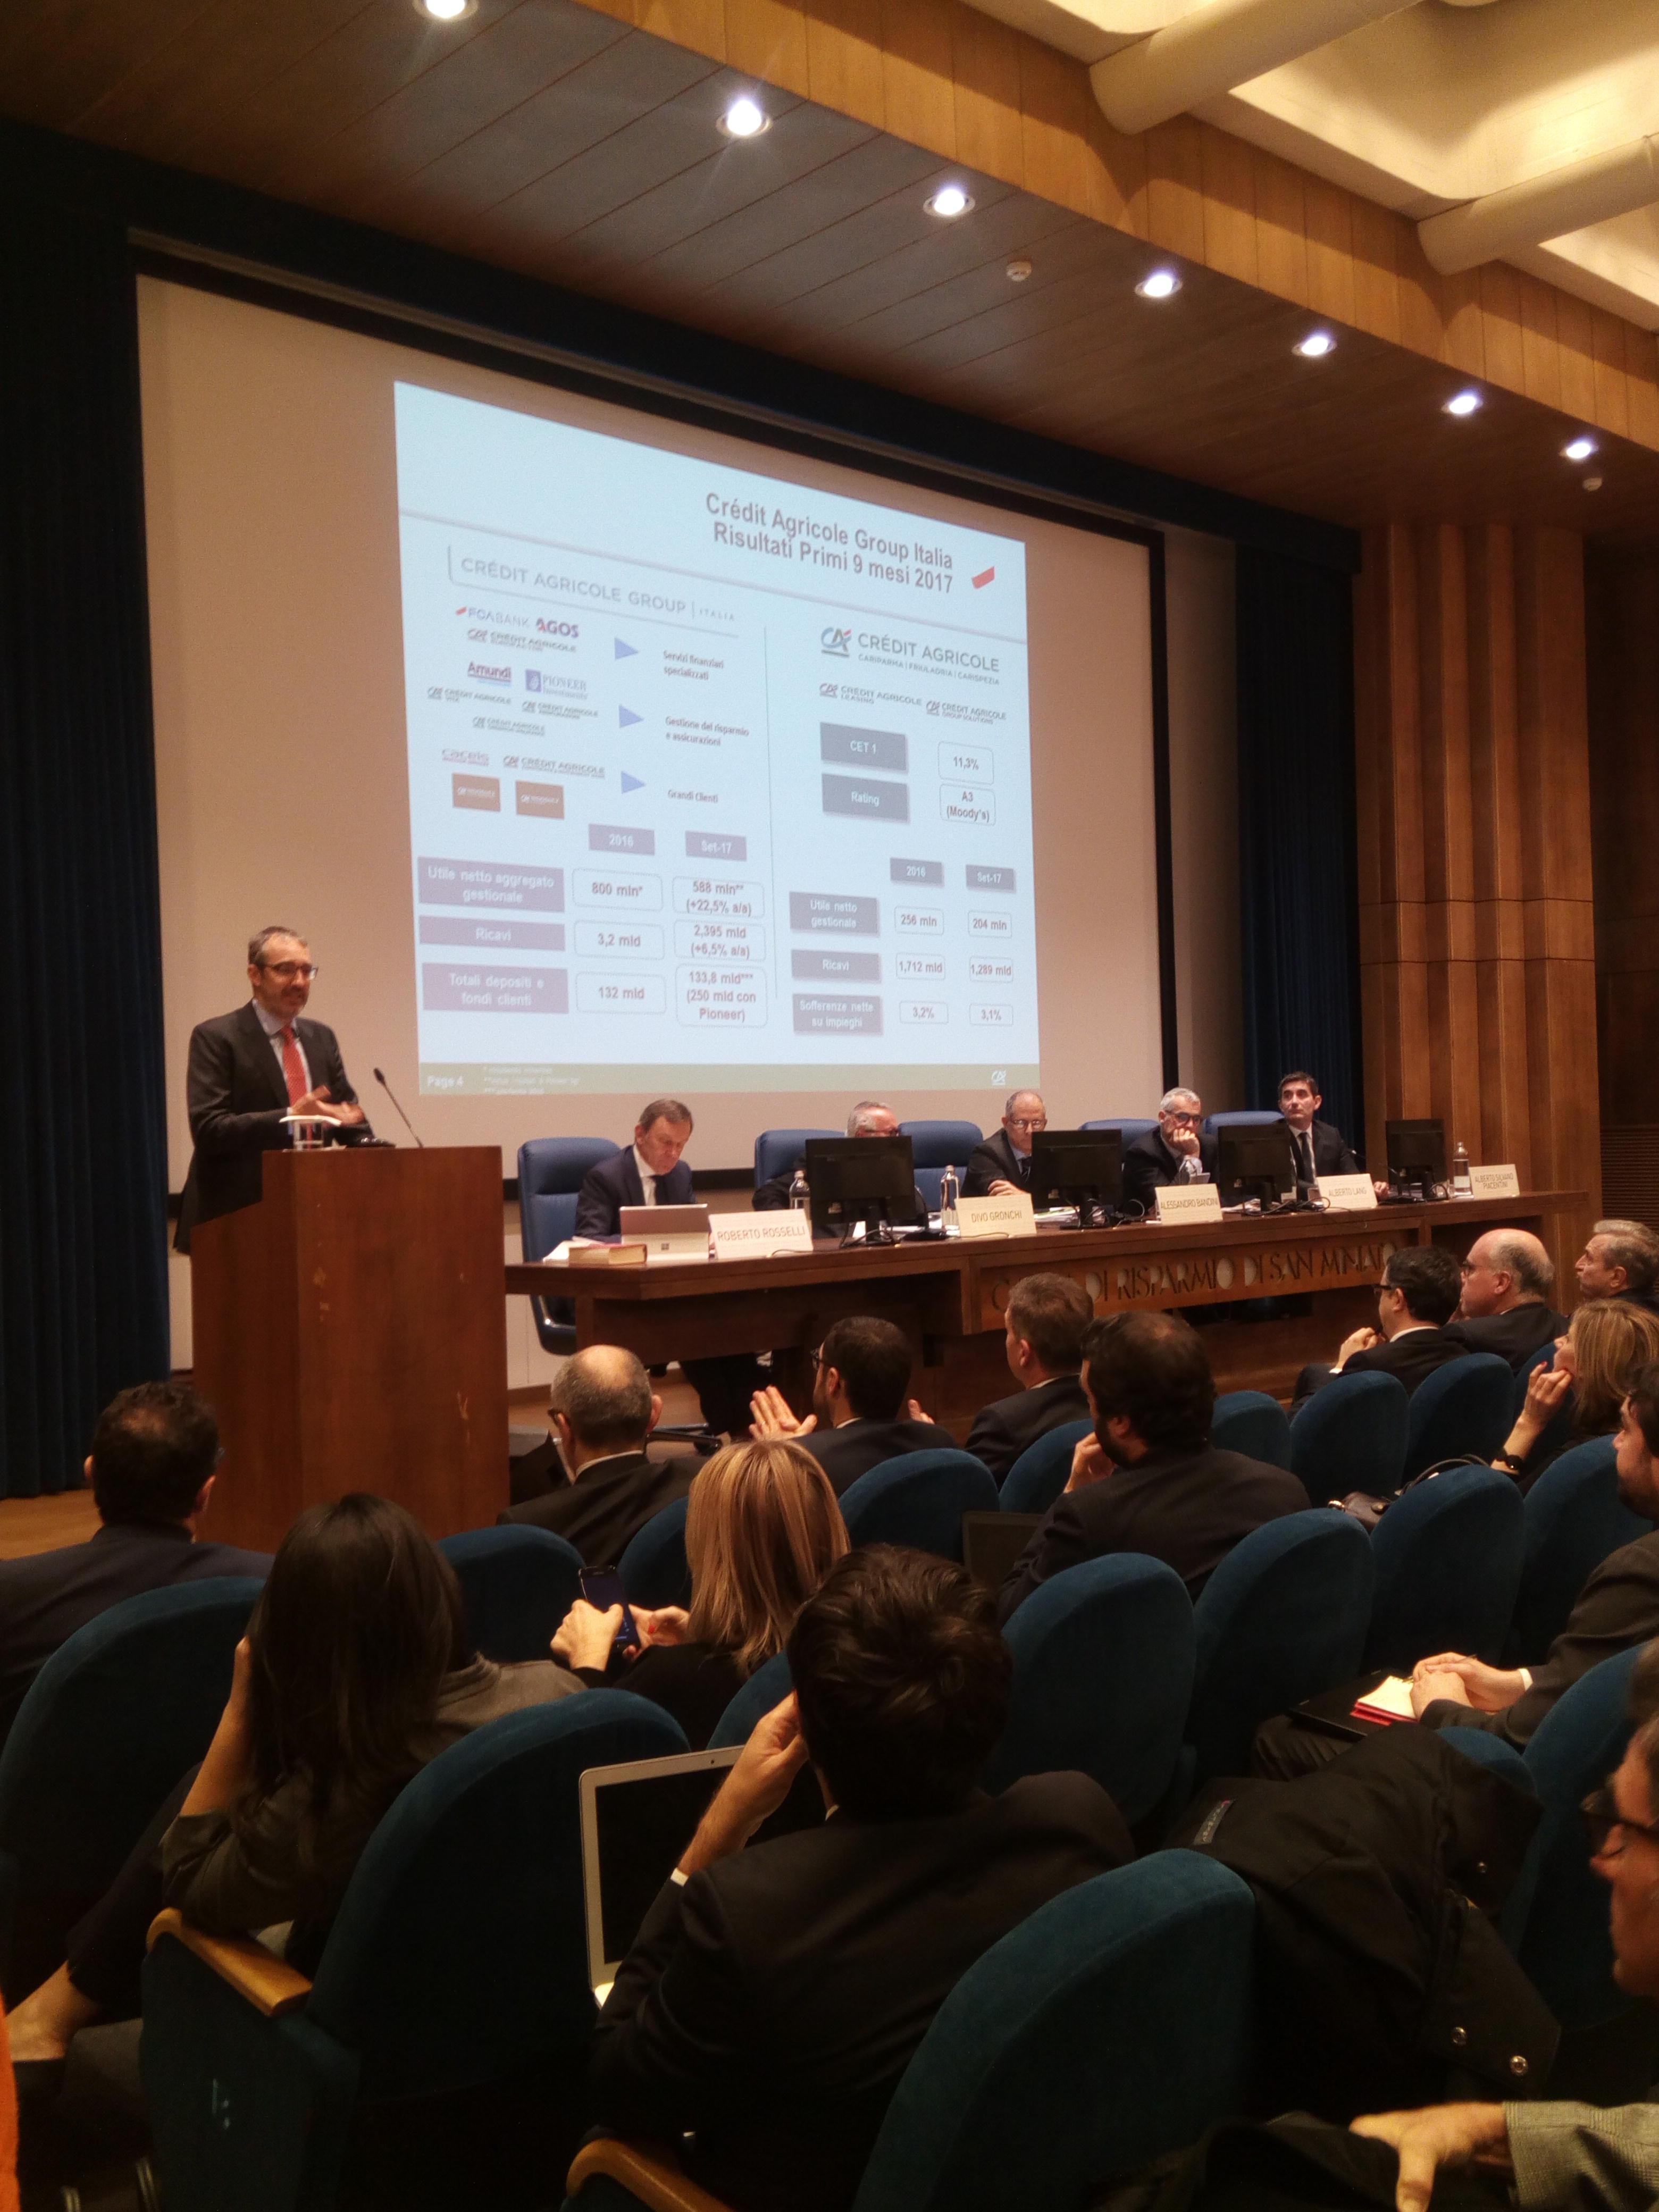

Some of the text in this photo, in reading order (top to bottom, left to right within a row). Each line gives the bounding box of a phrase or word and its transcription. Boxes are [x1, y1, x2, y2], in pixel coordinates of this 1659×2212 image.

[706, 492, 952, 569] Crédit Agricole Group Italia
[714, 521, 952, 593] Risultati Primi 9 mesi 2017
[462, 558, 529, 583] CRÉDIT
[534, 573, 621, 602] AGRICOLE
[629, 591, 685, 614] GROUP
[536, 617, 579, 638] AGOS
[664, 650, 724, 669] Servizi finanziari
[858, 633, 1000, 672] CRÉDIT AGRICOLE
[468, 661, 512, 680] Amundi
[664, 666, 709, 680] specializzati
[858, 653, 904, 669] CARIPARMA
[958, 671, 1000, 685] CARISPEZIA
[665, 716, 750, 737] Gestione del risparmio
[672, 733, 722, 746] assicurazioni
[850, 740, 877, 755] CET 1
[953, 756, 979, 770] 11,3%
[668, 790, 718, 803] Grandi Clienti
[851, 790, 880, 808] Rating
[961, 791, 974, 802] A3
[609, 833, 634, 848] 2016
[701, 839, 733, 854] Set-17
[428, 866, 555, 889] Utile netto aggregato
[906, 865, 926, 878] 2016
[977, 872, 1002, 884] Set-17
[462, 889, 524, 903] gestionale
[592, 882, 612, 895] 800
[686, 898, 752, 917] (+22,5% a/a)
[810, 899, 858, 914] Utile netto
[811, 916, 857, 929] gestionale
[920, 915, 937, 927] mln
[973, 918, 1008, 931] 204 mln
[476, 927, 512, 942] Ricavi
[693, 924, 747, 939] 2,395 mld
[598, 933, 642, 948] 3,2 mld
[691, 942, 750, 960] (+6,5% a/a)
[822, 959, 850, 971] Ricavi
[899, 960, 943, 975] 1,712 mld
[970, 963, 1012, 977] 1,289 mld
[450, 973, 545, 990] Totali depositi e
[689, 971, 717, 985] 133,8
[461, 992, 532, 1007] fondi clienti
[599, 986, 645, 1000] 132 mld
[686, 989, 757, 1004] (250 mld con
[699, 1007, 746, 1023] Pioneer)
[912, 1008, 935, 1020] 3,2%
[981, 1009, 1001, 1021] 3,1%
[811, 1015, 862, 1030] su impieghi
[427, 1075, 464, 1090] Page 4
[1475, 1173, 1495, 1183] ALBERTO
[1328, 1187, 1367, 1197] ALBERTO LANG
[1160, 1199, 1196, 1211] ALESSANDRO
[971, 1210, 1023, 1222] DIVO GRONCHI
[718, 1225, 806, 1243] ROBERTO ROSSELLI
[1086, 1271, 1109, 1303] DI
[1117, 1256, 1234, 1301] RISPARMIO
[1243, 1255, 1264, 1287] DI
[1269, 1250, 1314, 1280] SAN
